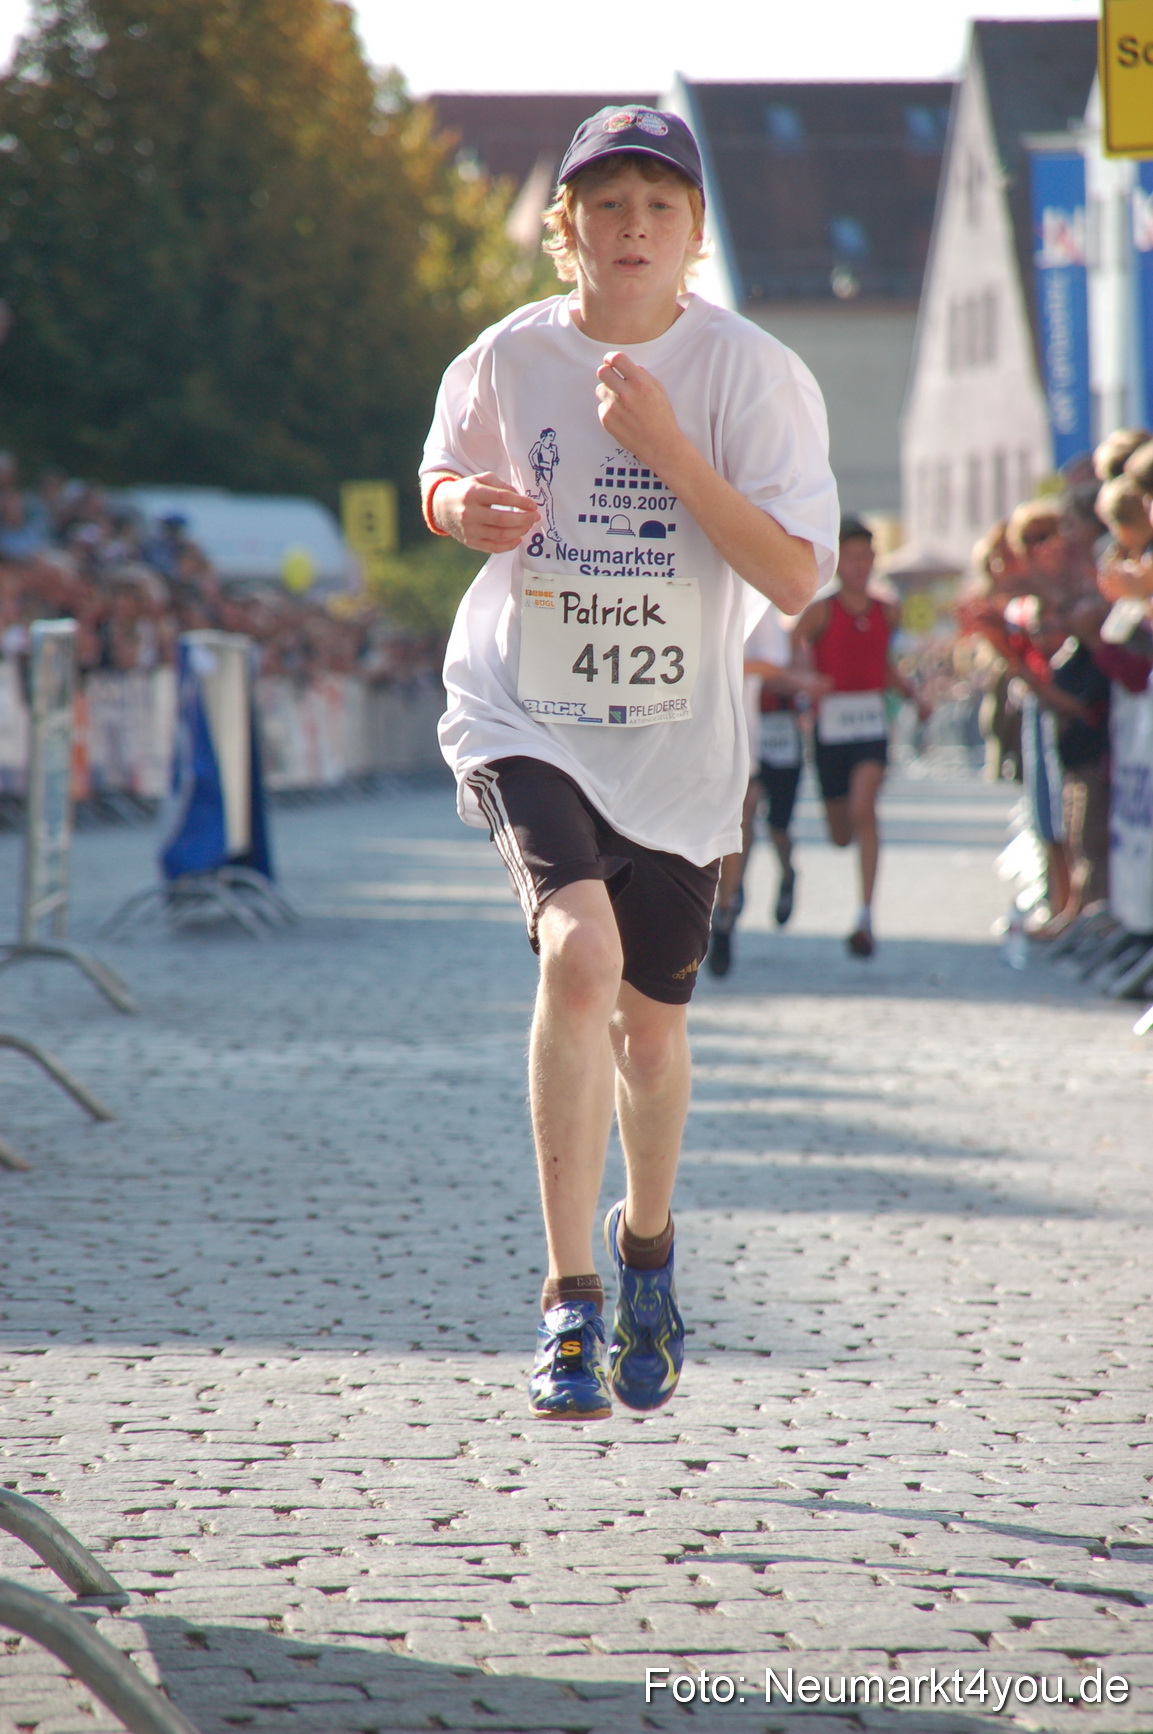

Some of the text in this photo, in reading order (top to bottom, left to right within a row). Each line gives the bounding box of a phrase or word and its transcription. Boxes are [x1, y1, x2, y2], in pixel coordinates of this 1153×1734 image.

[589, 493, 678, 511] 16.09.2007
[526, 532, 676, 567] 8. Neumarkter
[559, 590, 667, 627] Patrick
[572, 643, 685, 685] 4123
[522, 699, 587, 717] BOCK
[629, 698, 688, 717] PFLEIDERER
